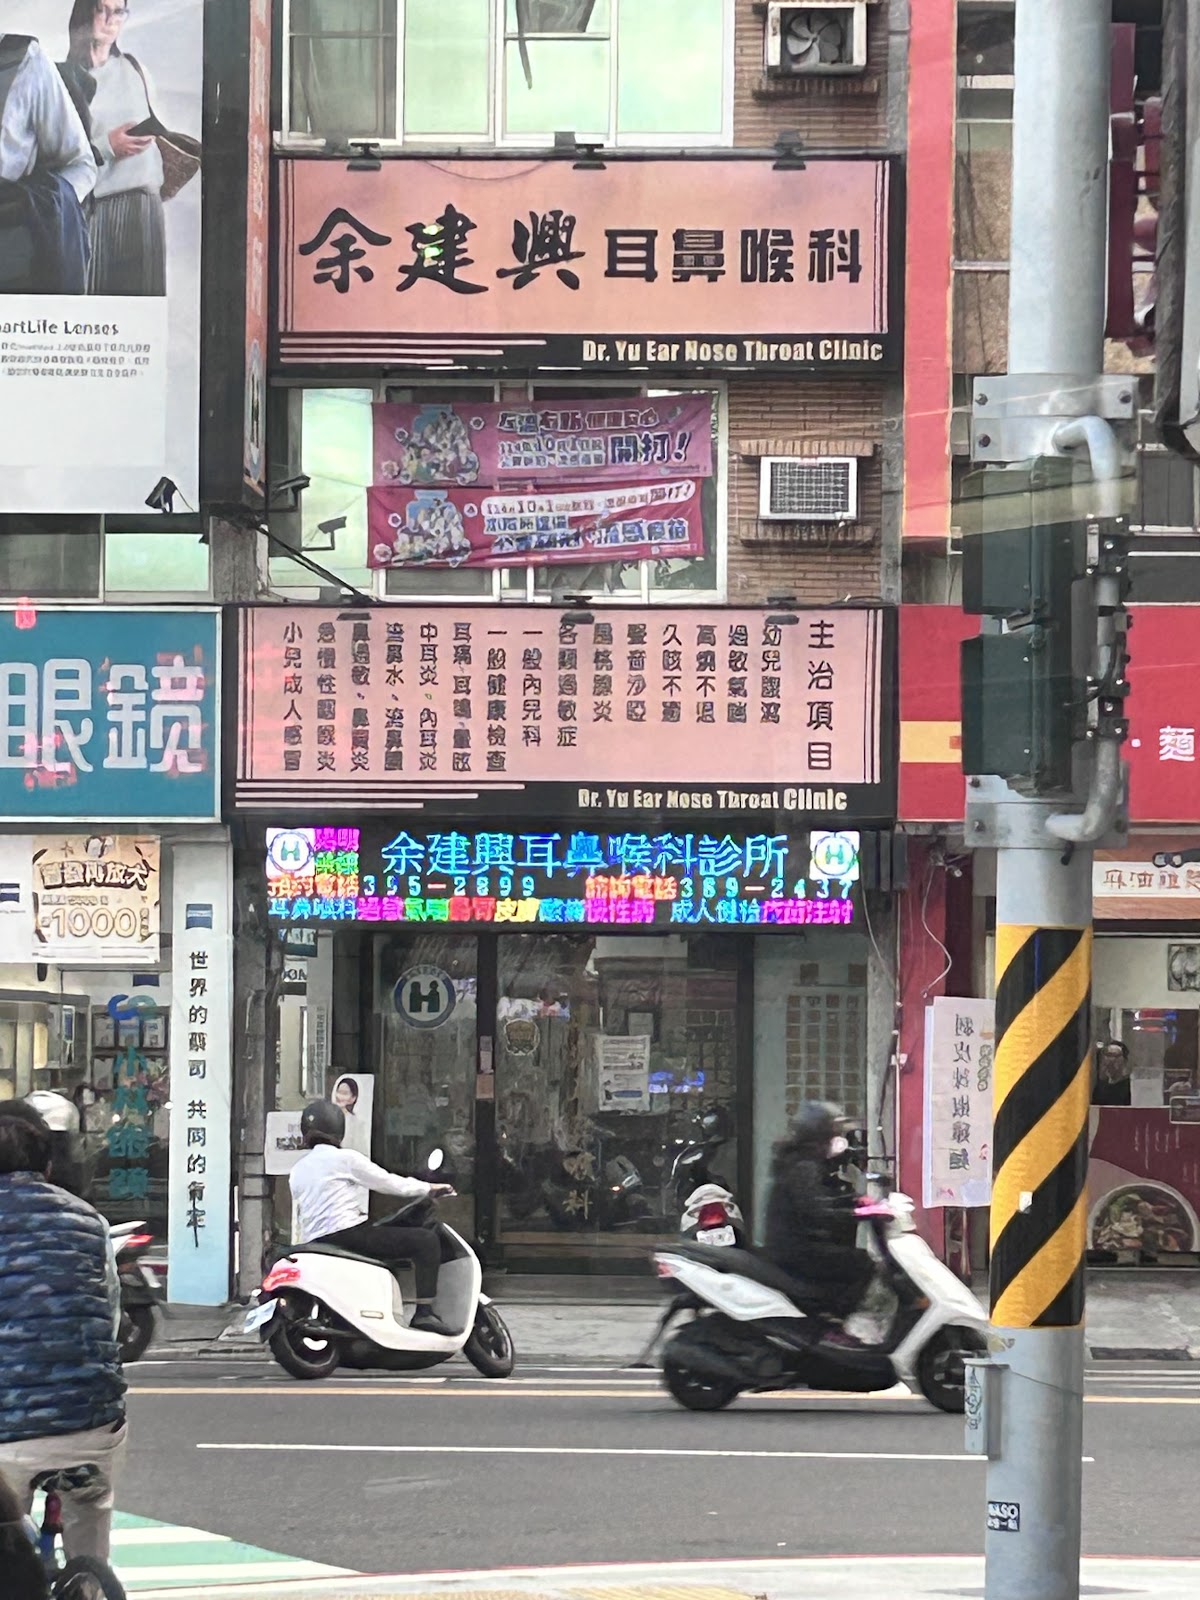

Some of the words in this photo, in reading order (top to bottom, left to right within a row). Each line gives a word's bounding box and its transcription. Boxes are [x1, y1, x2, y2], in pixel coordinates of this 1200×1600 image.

[0, 320, 58, 335] artLife
[582, 339, 611, 362] Dr.
[615, 340, 641, 362] Yu
[646, 340, 680, 362] Ear
[684, 340, 738, 362] Nose
[743, 340, 815, 362] Throat
[818, 339, 884, 362] Clinic
[806, 619, 835, 771] 主治項目
[0, 655, 205, 773] 眼鏡
[578, 788, 602, 809] Dr.
[606, 788, 629, 809] Yu
[633, 788, 663, 809] Ear
[667, 789, 713, 809] Nose
[717, 789, 779, 809] Throat
[783, 787, 848, 811] Clinic
[381, 830, 790, 879] 余建興耳鼻喉科診所
[51, 907, 137, 938] 1000
